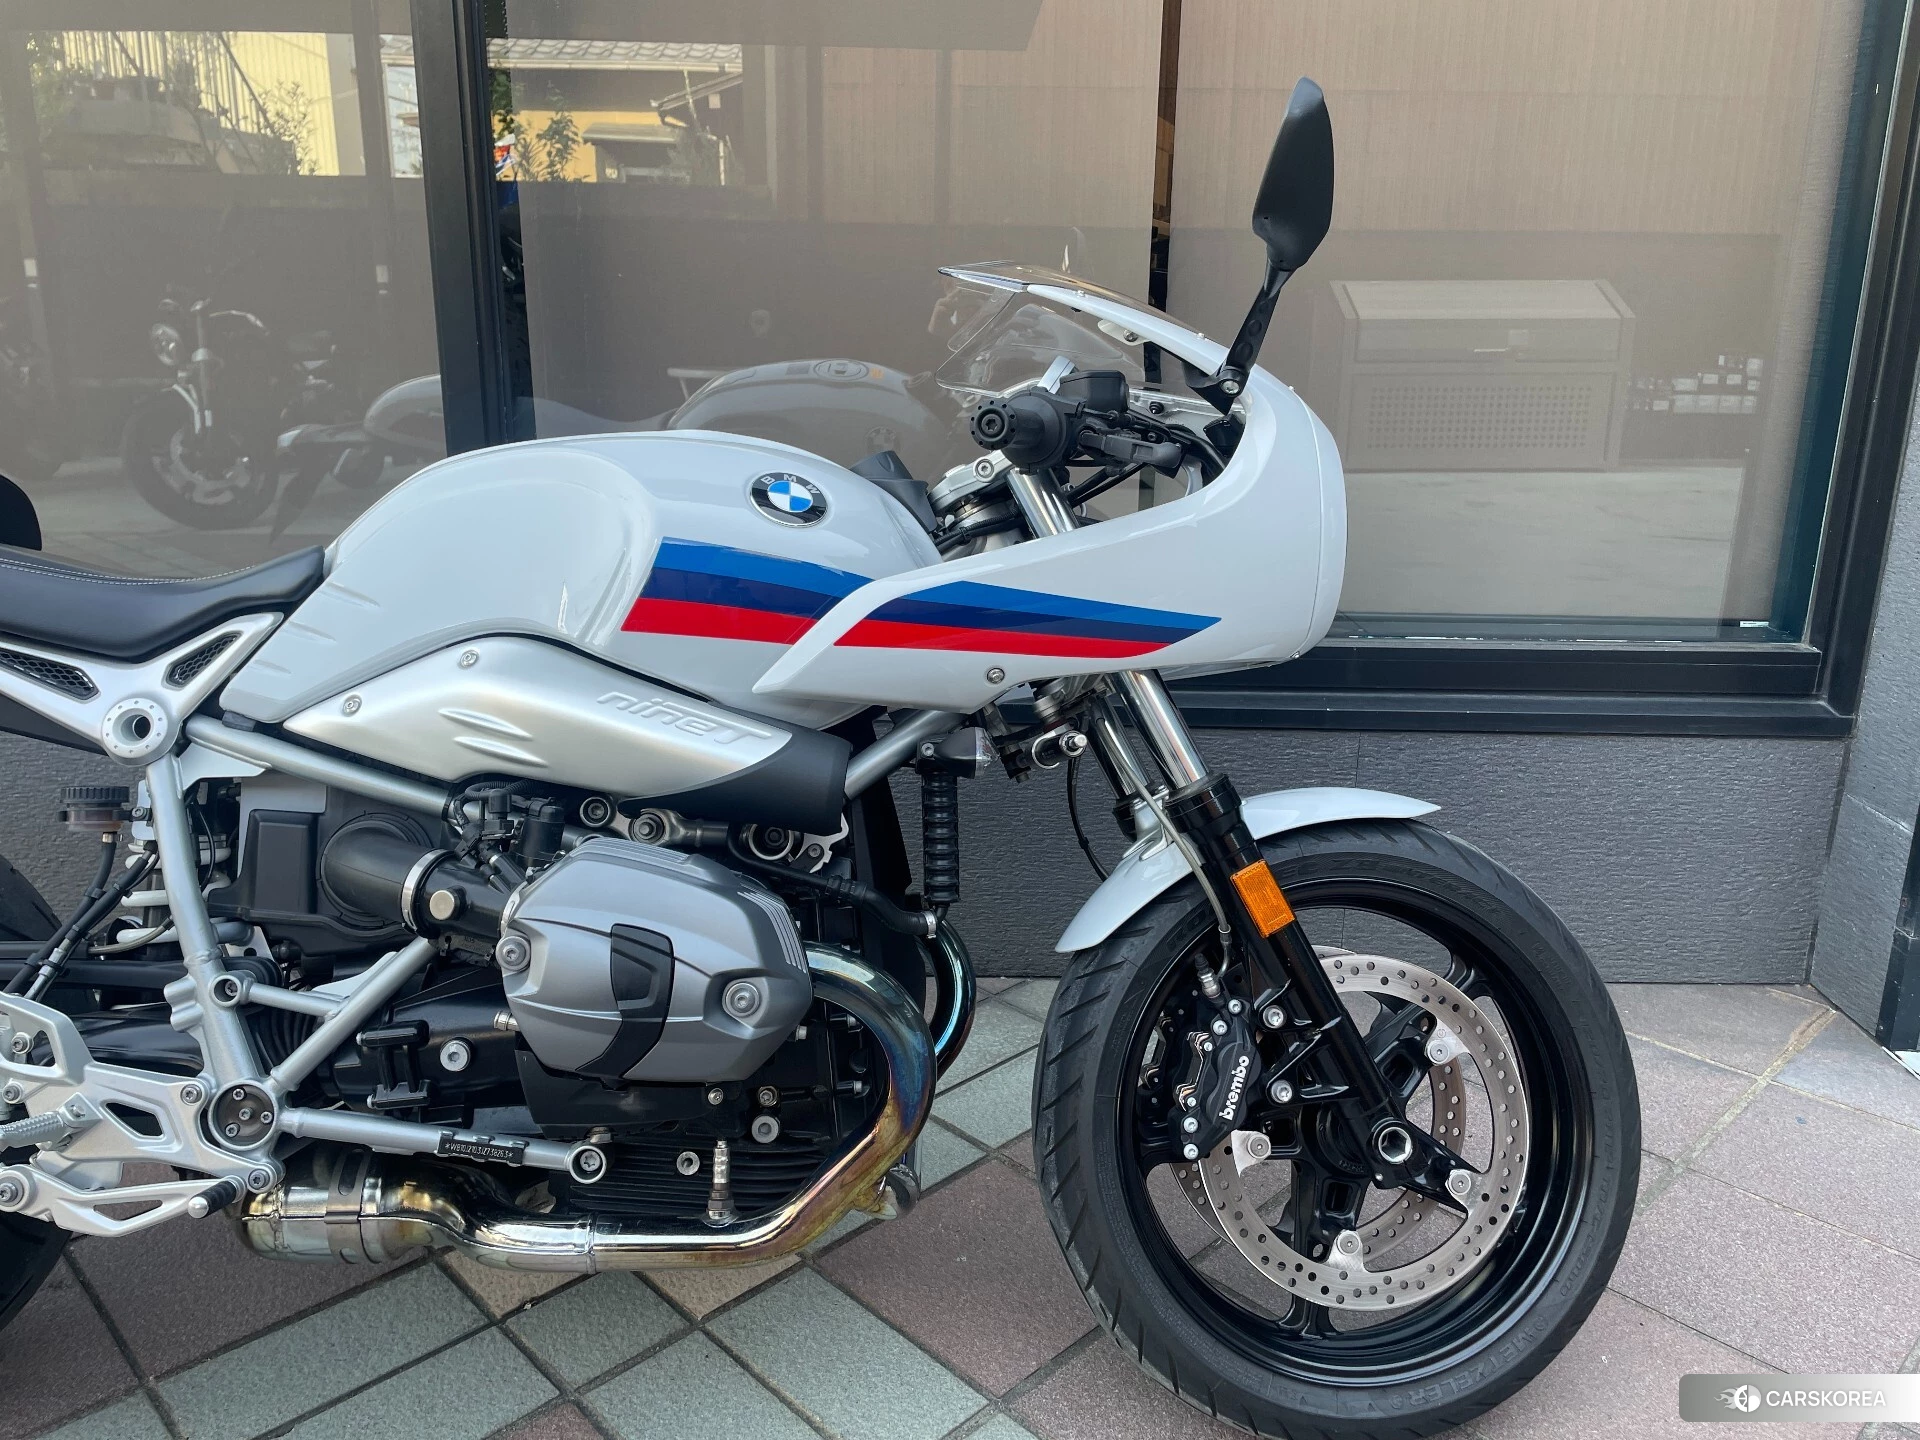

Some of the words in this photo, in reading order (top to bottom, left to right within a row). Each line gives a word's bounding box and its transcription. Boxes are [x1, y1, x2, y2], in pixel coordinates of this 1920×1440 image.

[761, 474, 820, 494] BMW
[597, 691, 772, 744] nineT
[1219, 1055, 1249, 1120] brembo
